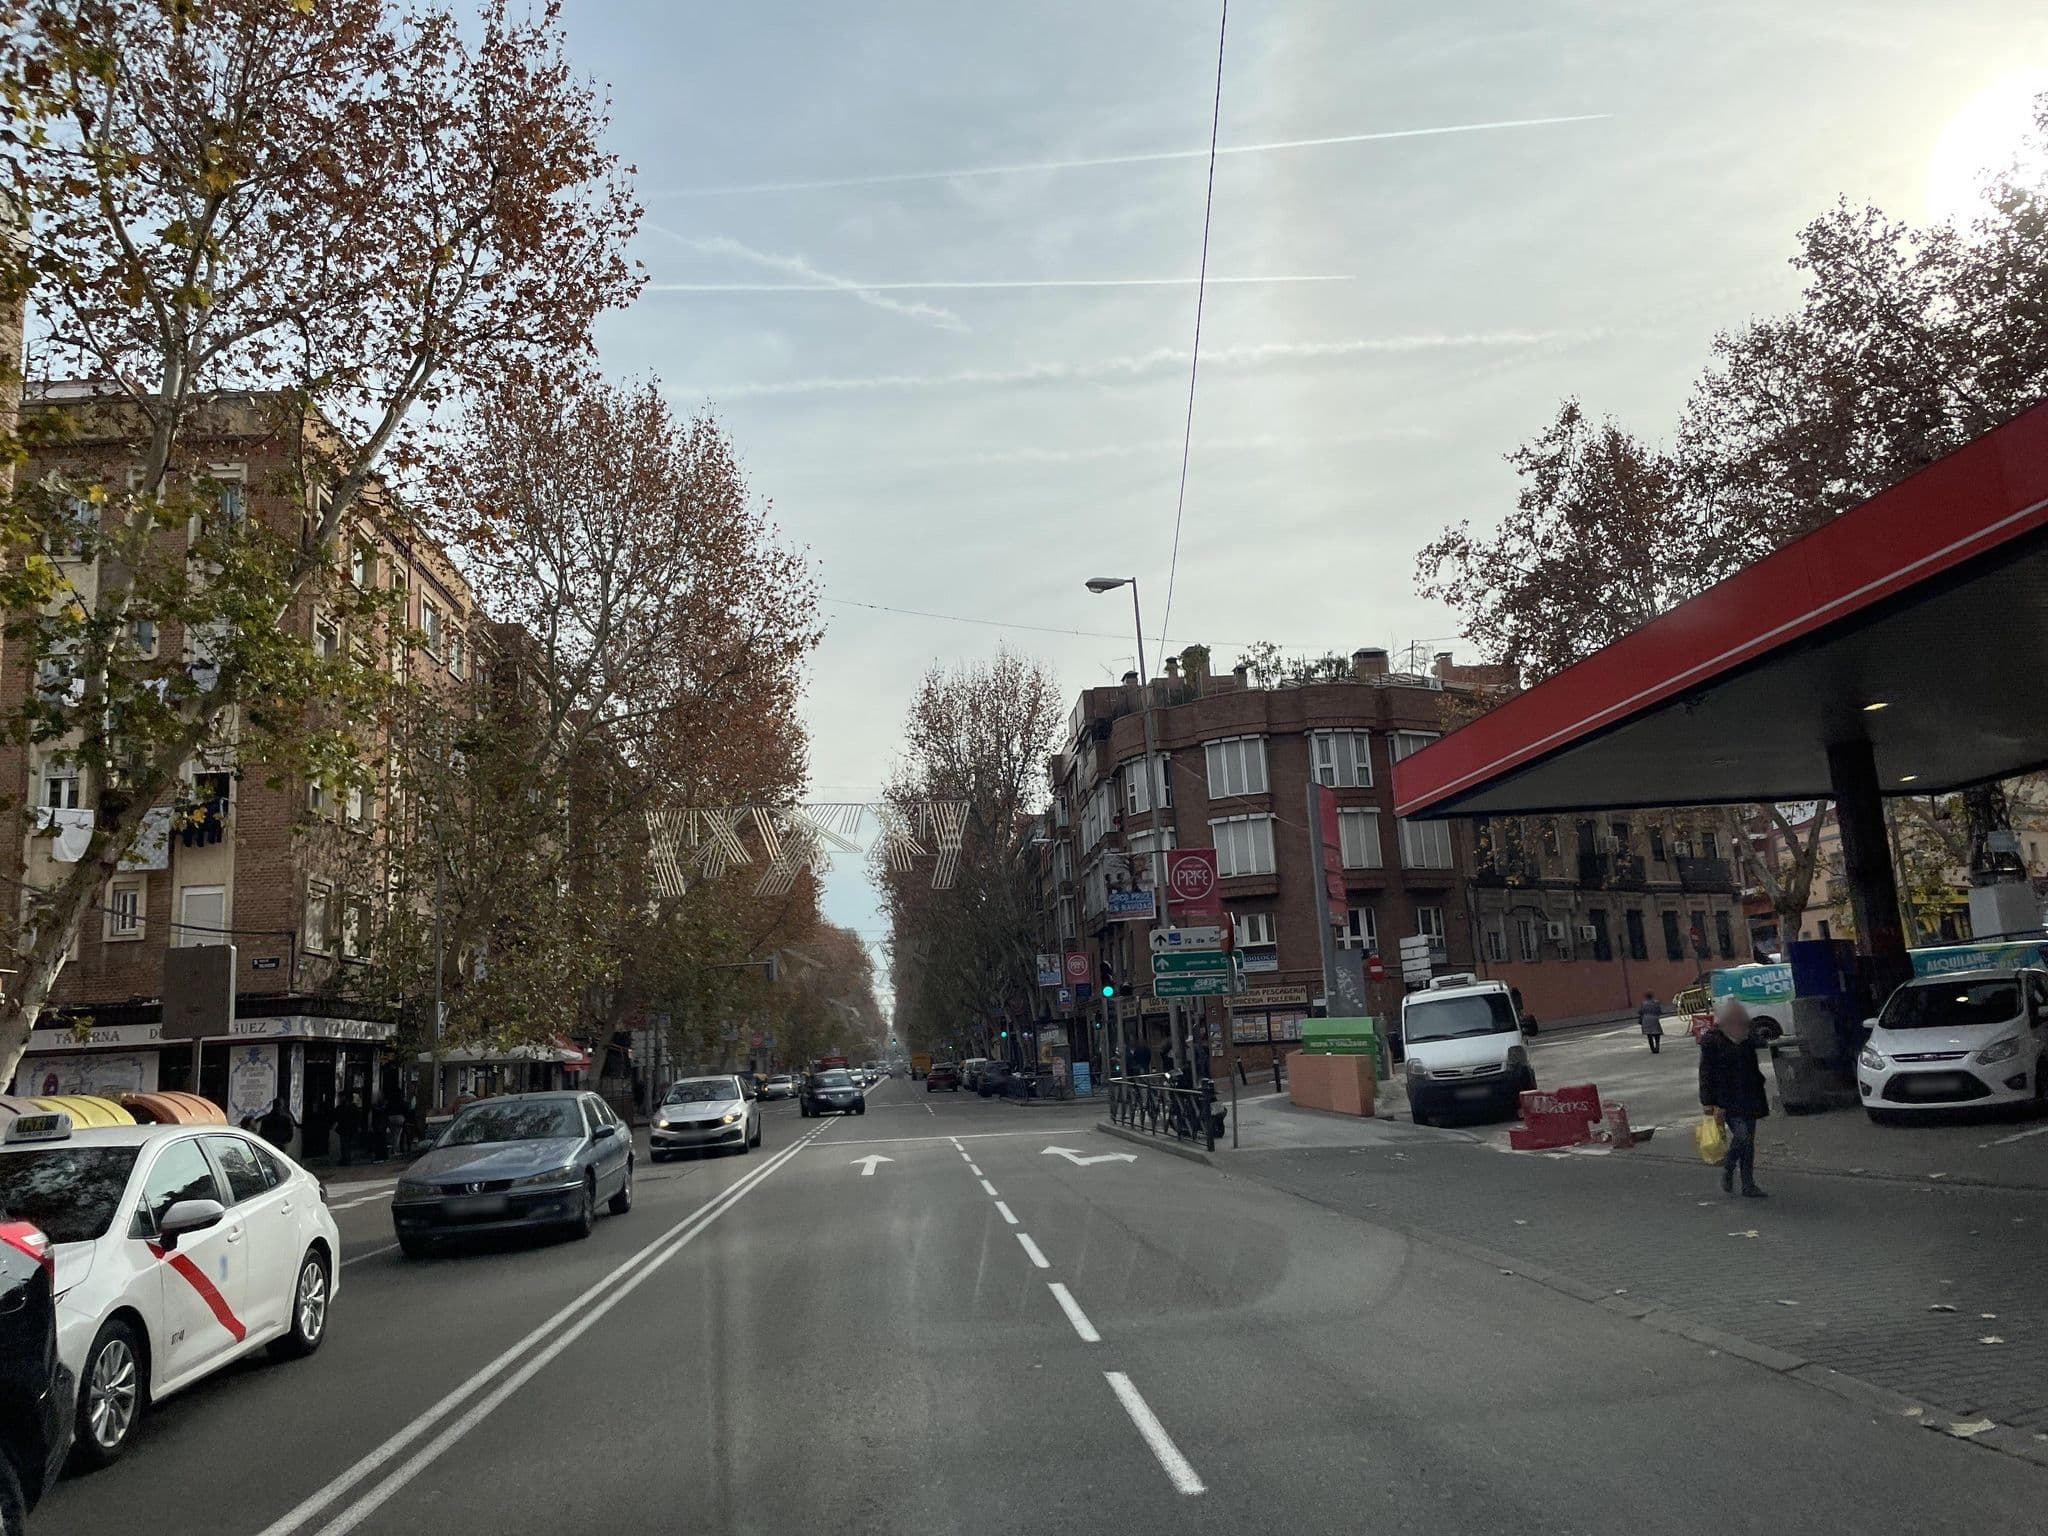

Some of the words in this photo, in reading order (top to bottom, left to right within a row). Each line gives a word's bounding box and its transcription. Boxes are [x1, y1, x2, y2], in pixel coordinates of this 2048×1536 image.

[1177, 869, 1209, 886] PRICE
[1742, 969, 1792, 988] ALQUILAM
[1059, 990, 1069, 1002] P
[55, 1030, 121, 1044] TARNA
